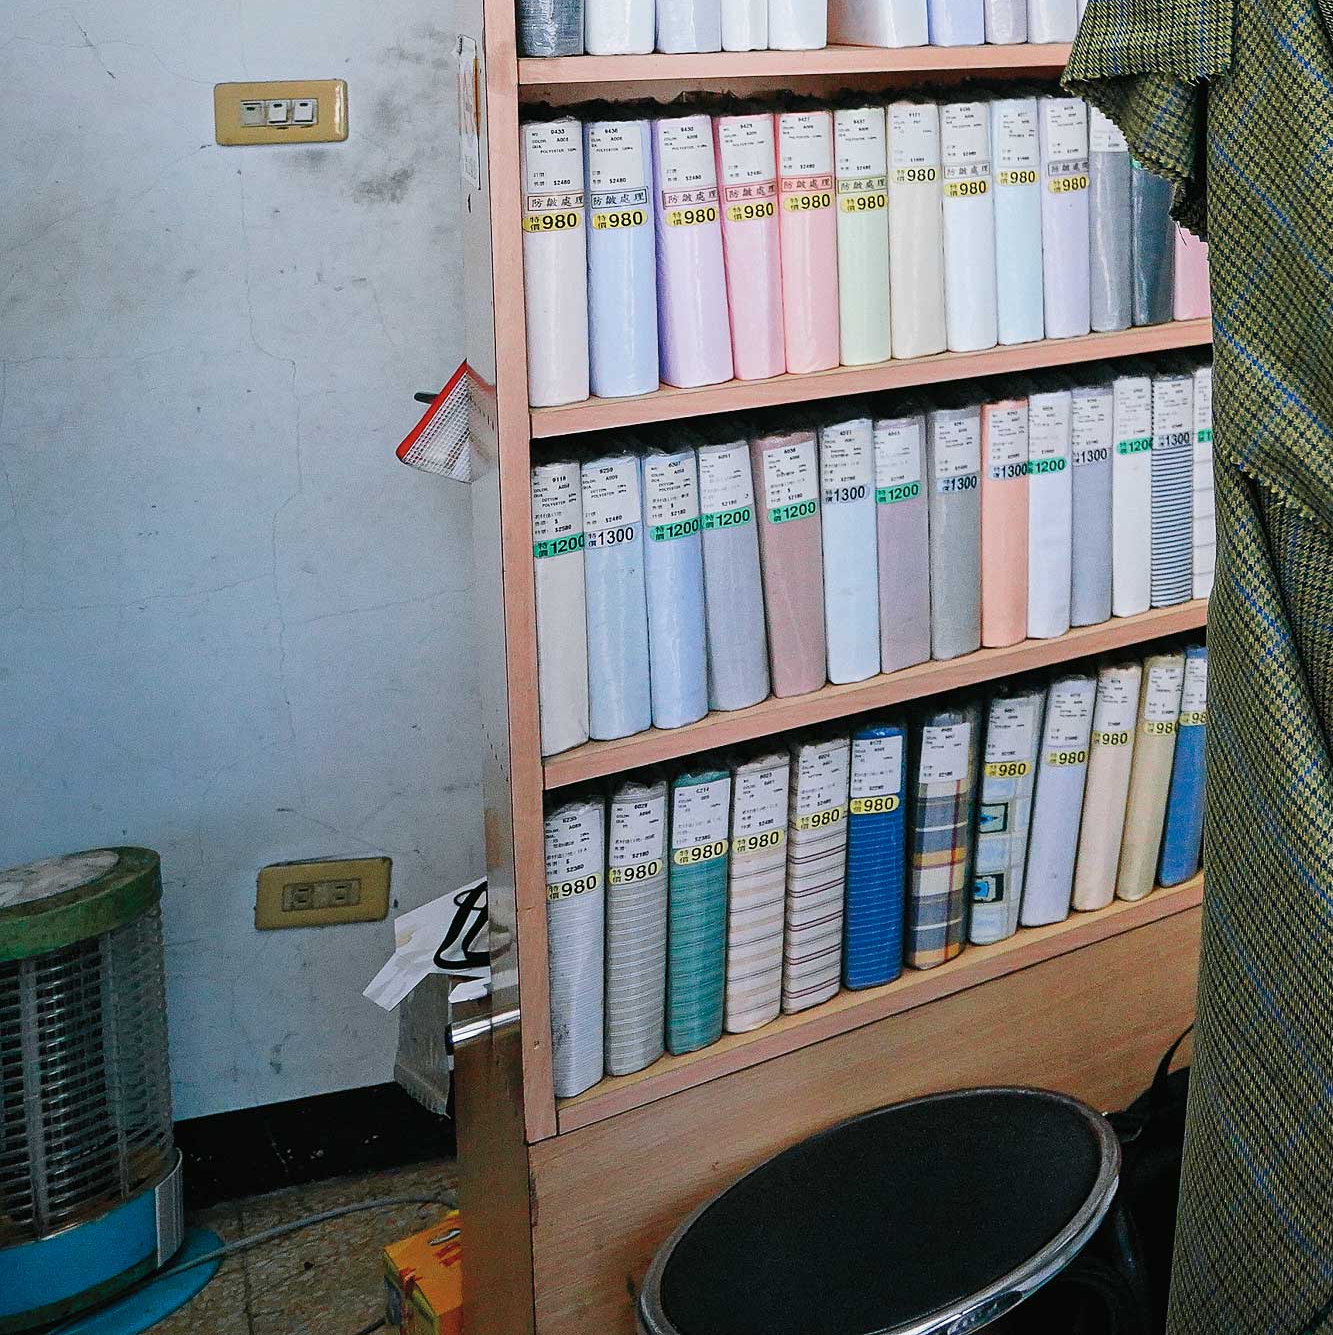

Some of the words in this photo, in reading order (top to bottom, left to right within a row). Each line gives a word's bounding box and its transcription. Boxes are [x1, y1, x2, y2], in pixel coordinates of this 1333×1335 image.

[907, 168, 936, 182] 980
[1010, 170, 1036, 184] 980
[960, 180, 987, 195] 980
[1062, 177, 1087, 191] 980
[593, 190, 644, 206] 防皺處理
[801, 194, 830, 210] 980
[857, 195, 885, 210] 980
[685, 208, 716, 224] 980
[744, 202, 774, 219] 980
[542, 213, 577, 230] 980
[609, 211, 643, 227] 980
[1165, 432, 1190, 446] 1300
[1081, 448, 1107, 462] 1300
[1000, 464, 1027, 478] 1300
[1036, 459, 1065, 473] 1200
[950, 476, 977, 491] 1300
[834, 485, 865, 501] 1300
[889, 484, 919, 500] 1200
[717, 509, 750, 526] 1200
[783, 502, 816, 519] 1200
[598, 527, 634, 545] 1300
[666, 519, 699, 538] 1200
[550, 535, 585, 553] 1200
[1102, 732, 1128, 745] 980
[1059, 751, 1085, 764] 980
[998, 763, 1026, 776] 980
[864, 798, 893, 811] 980
[811, 809, 839, 827] 980
[749, 832, 779, 849] 980
[691, 842, 723, 860] 980
[624, 862, 658, 881] 980
[562, 875, 597, 896] 980
